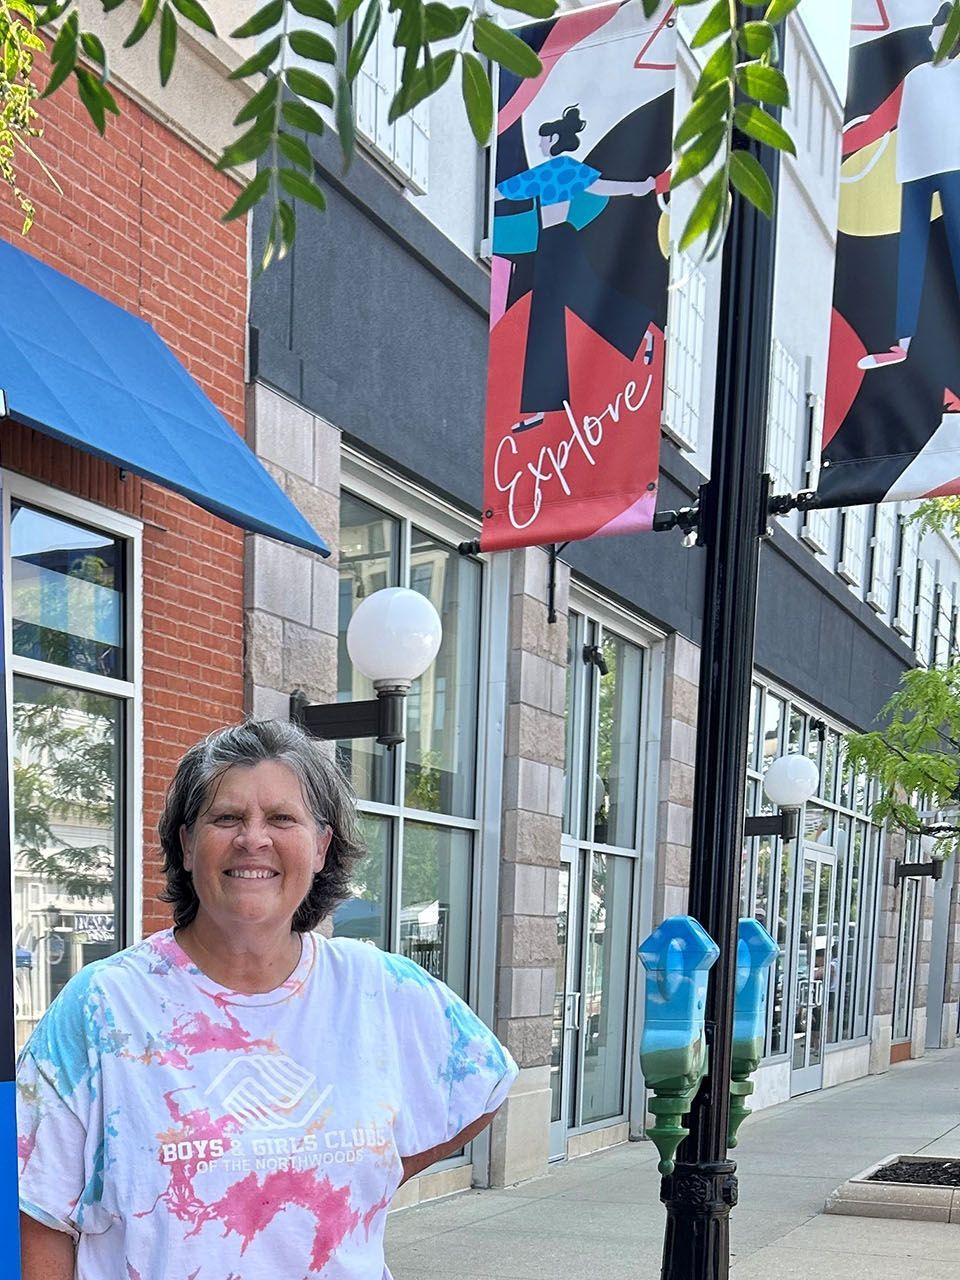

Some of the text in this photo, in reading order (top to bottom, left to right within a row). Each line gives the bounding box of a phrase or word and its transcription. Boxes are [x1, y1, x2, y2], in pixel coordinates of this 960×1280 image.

[494, 374, 652, 529] Explore
[162, 1139, 225, 1162] BOYS
[230, 1137, 246, 1157] &
[253, 1134, 318, 1156] GIRLS
[196, 1149, 365, 1174] OF THE NORTHWOODS
